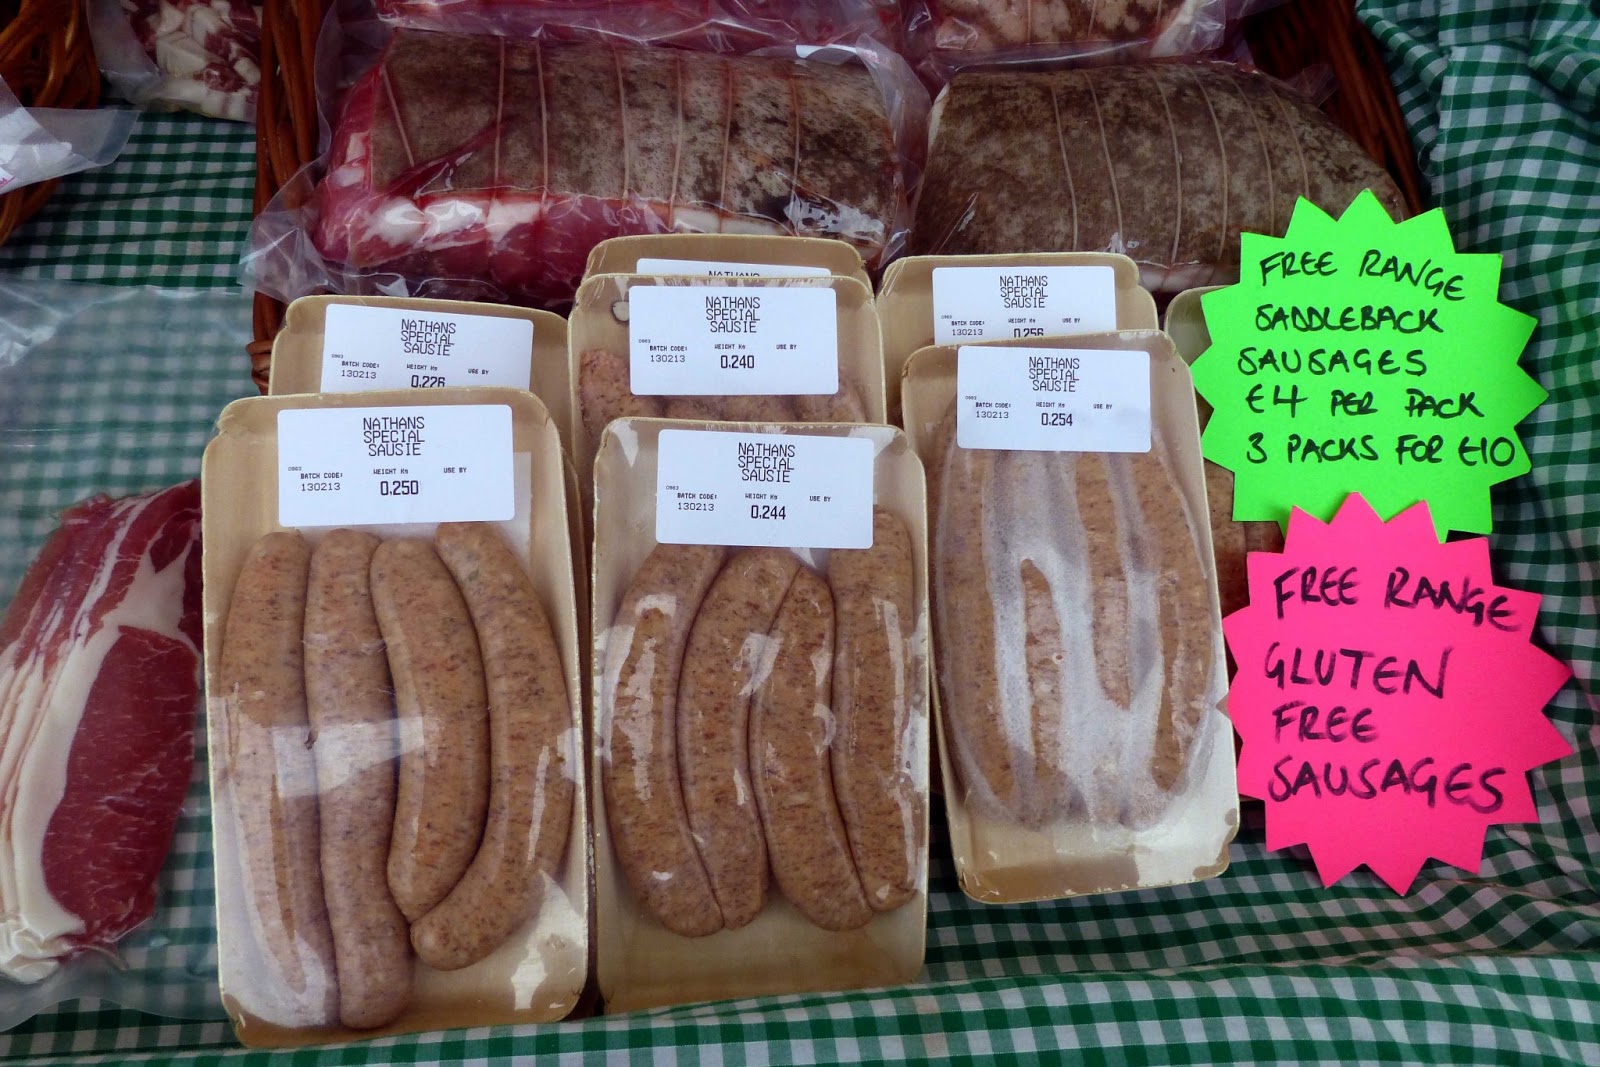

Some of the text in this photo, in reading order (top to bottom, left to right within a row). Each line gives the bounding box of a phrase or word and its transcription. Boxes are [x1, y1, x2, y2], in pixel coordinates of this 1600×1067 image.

[1000, 276, 1048, 287] NATHANS
[1260, 249, 1465, 301] FREE RANGE
[1000, 287, 1048, 298] SPECIAL
[706, 296, 760, 309] NATHANS
[1004, 298, 1045, 308] SAUSIE
[706, 309, 760, 321] SPECIAL
[1256, 304, 1444, 333] SADDLEBACK
[401, 319, 456, 334] NATHANS
[710, 321, 757, 333] SAUSIE
[952, 328, 983, 336] 130213
[401, 331, 454, 345] SPECIAL
[404, 342, 450, 356] SAUSIE
[650, 355, 685, 363] 130213
[1029, 357, 1080, 369] NATHANS
[1238, 347, 1427, 376] SAUSAGES
[341, 370, 377, 379] 130213
[1029, 369, 1079, 381] SPECIAL
[1033, 380, 1076, 392] SAUSIE
[1330, 390, 1378, 414] PER
[1406, 388, 1484, 419] PACK
[976, 411, 1009, 419] 130213
[363, 417, 425, 430] NATHANS
[363, 430, 425, 443] SPECIAL
[369, 443, 421, 456] SAUSIE
[738, 442, 795, 458] NATHANS
[1247, 432, 1268, 464] 3
[1287, 434, 1379, 463] PACKS
[1395, 434, 1444, 465] FOR
[738, 456, 794, 470] SPECIAL
[742, 468, 790, 483] SAUSIE
[301, 482, 341, 491] 130213
[678, 502, 714, 511] 130213
[1273, 566, 1522, 632] FREE RANGE
[1265, 642, 1453, 699] GLUTEN
[1272, 701, 1380, 743] FREE
[1268, 755, 1506, 813] SAUSAGES
